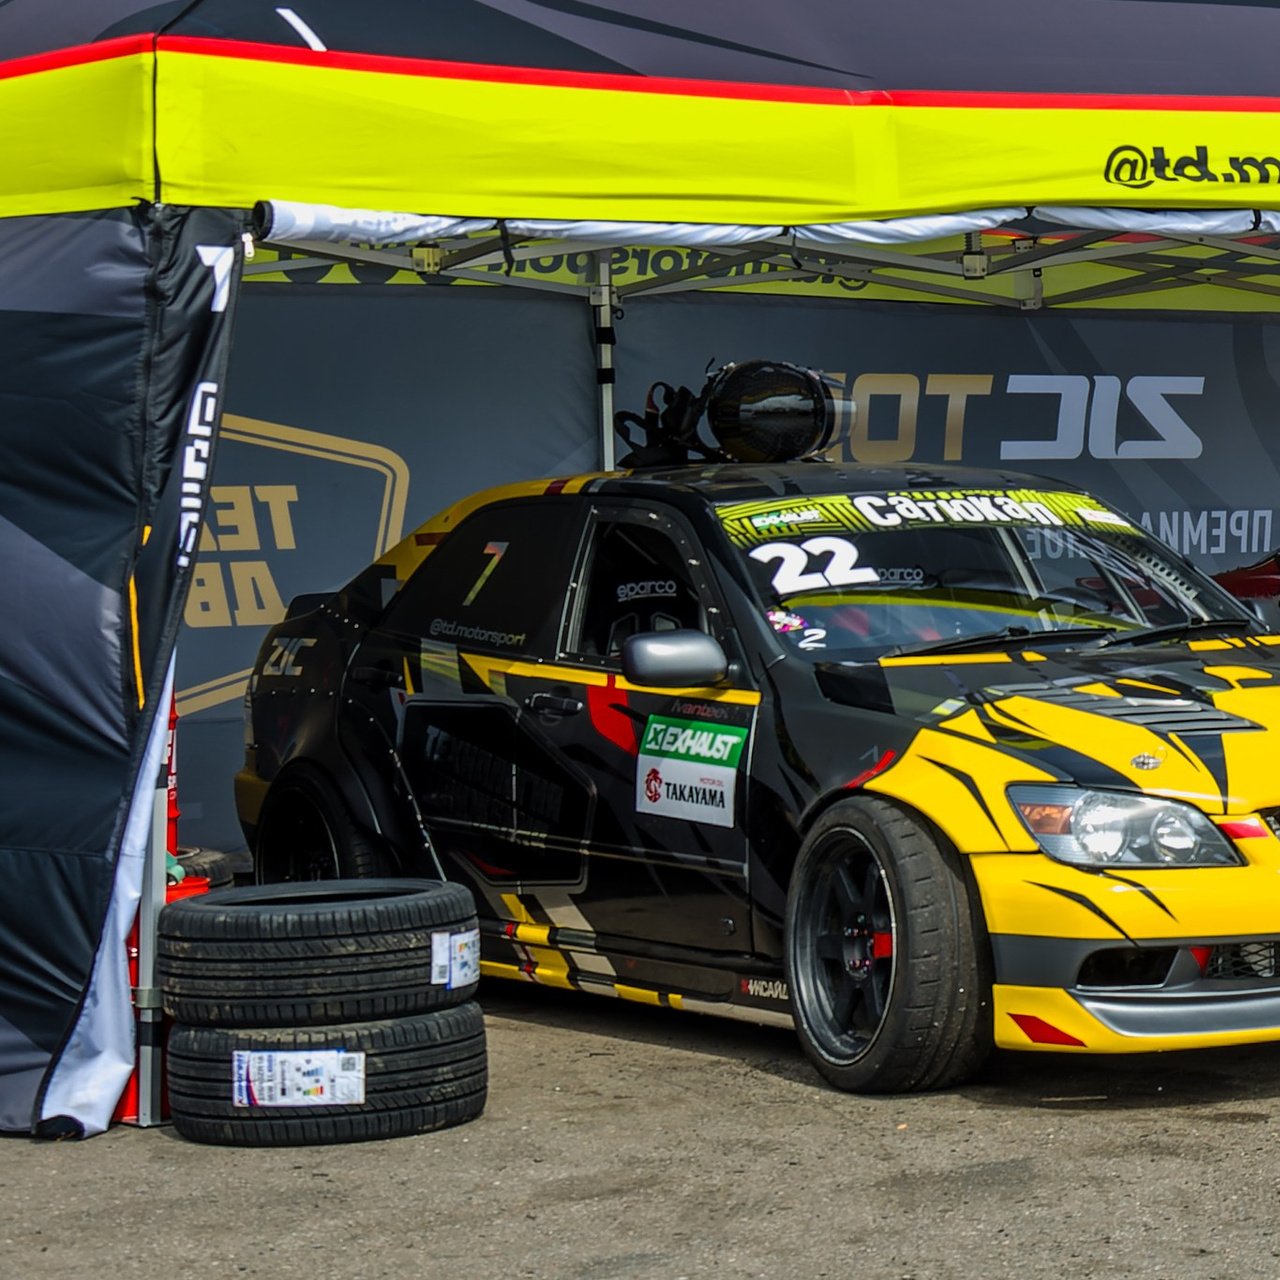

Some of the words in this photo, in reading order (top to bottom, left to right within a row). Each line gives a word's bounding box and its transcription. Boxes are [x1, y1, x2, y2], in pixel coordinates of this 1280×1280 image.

[748, 536, 881, 596] 22
[877, 567, 925, 582] parco
[661, 726, 742, 761] EXHAUST
[664, 782, 726, 809] TAKAYAMA
